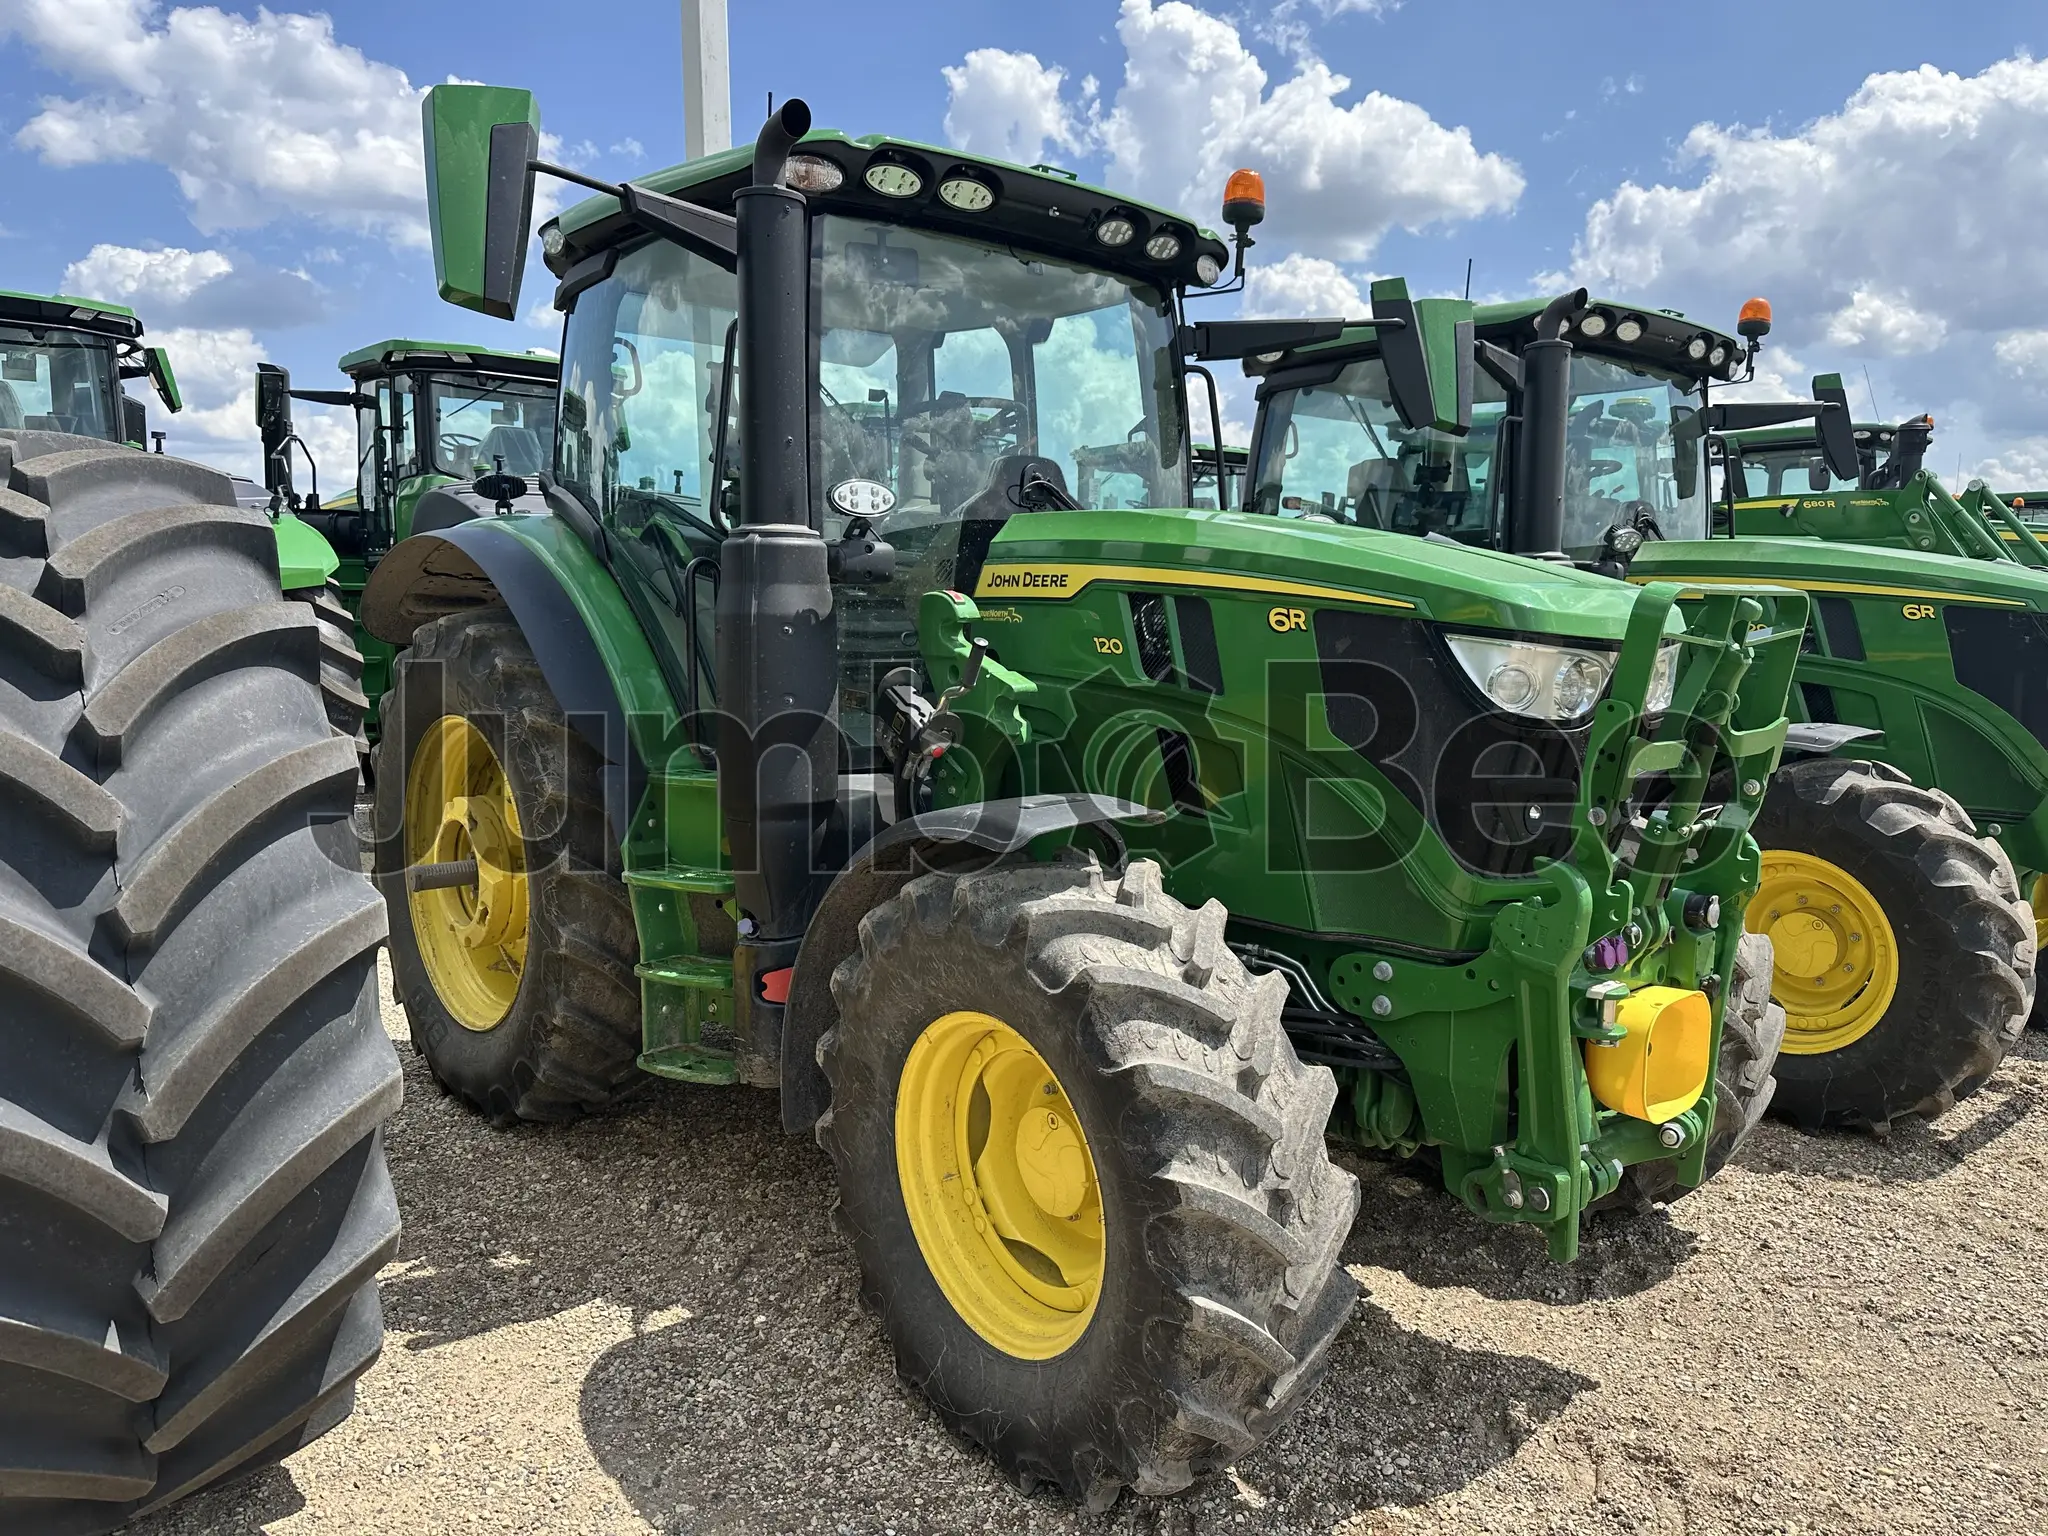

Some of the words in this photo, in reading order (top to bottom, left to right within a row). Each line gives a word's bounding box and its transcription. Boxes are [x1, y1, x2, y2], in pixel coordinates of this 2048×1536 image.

[1802, 500, 1826, 509] 680
[987, 572, 1020, 588] JOHN
[1022, 571, 1069, 588] DEERE
[1267, 605, 1308, 634] 6R
[1902, 603, 1936, 620] 6R
[1093, 637, 1124, 655] 120
